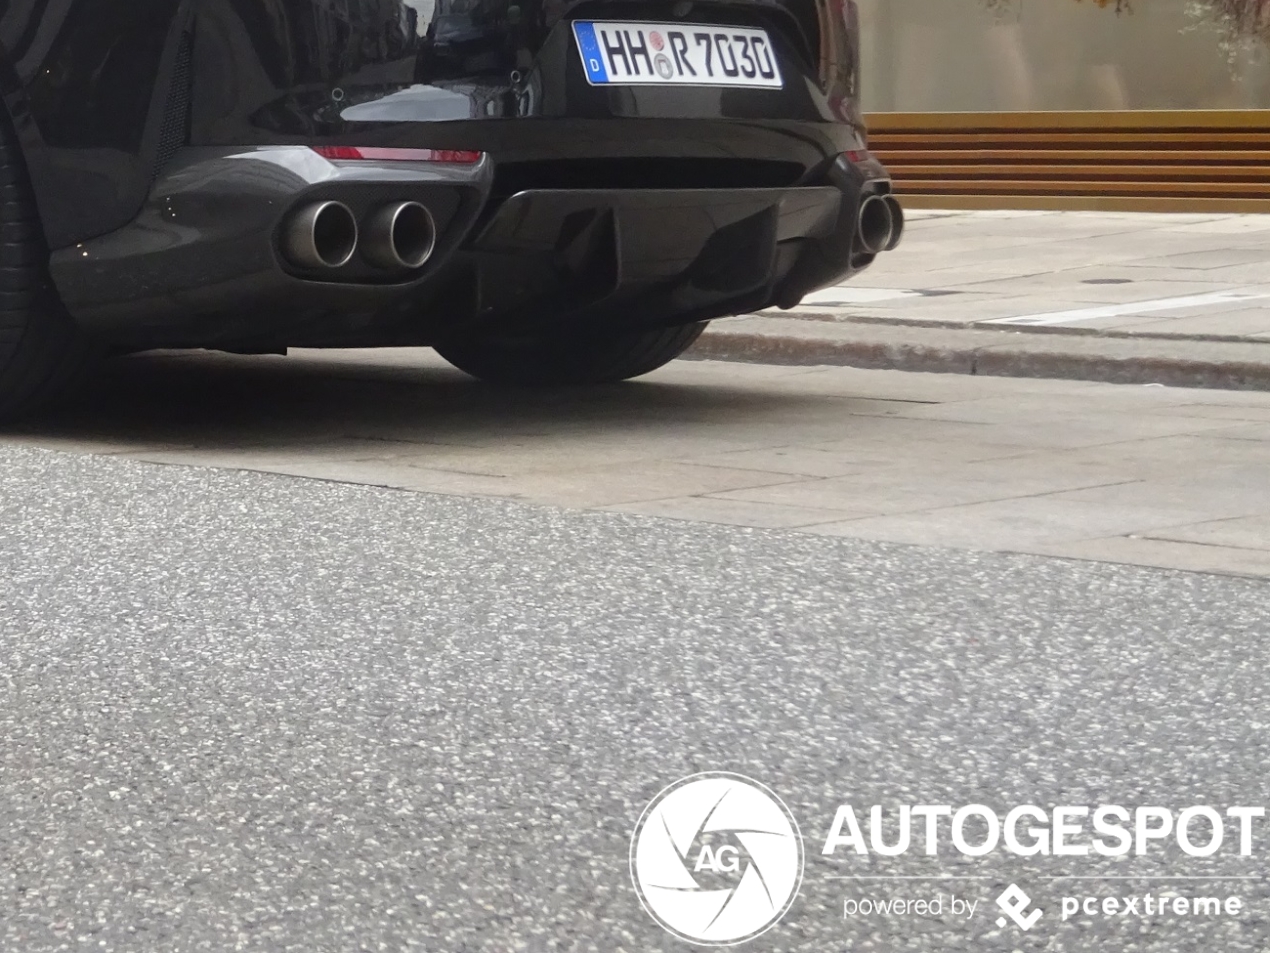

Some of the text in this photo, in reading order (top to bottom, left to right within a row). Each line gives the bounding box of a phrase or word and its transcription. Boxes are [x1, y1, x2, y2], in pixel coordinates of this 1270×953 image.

[590, 58, 600, 73] D
[600, 30, 776, 80] HH R 7030
